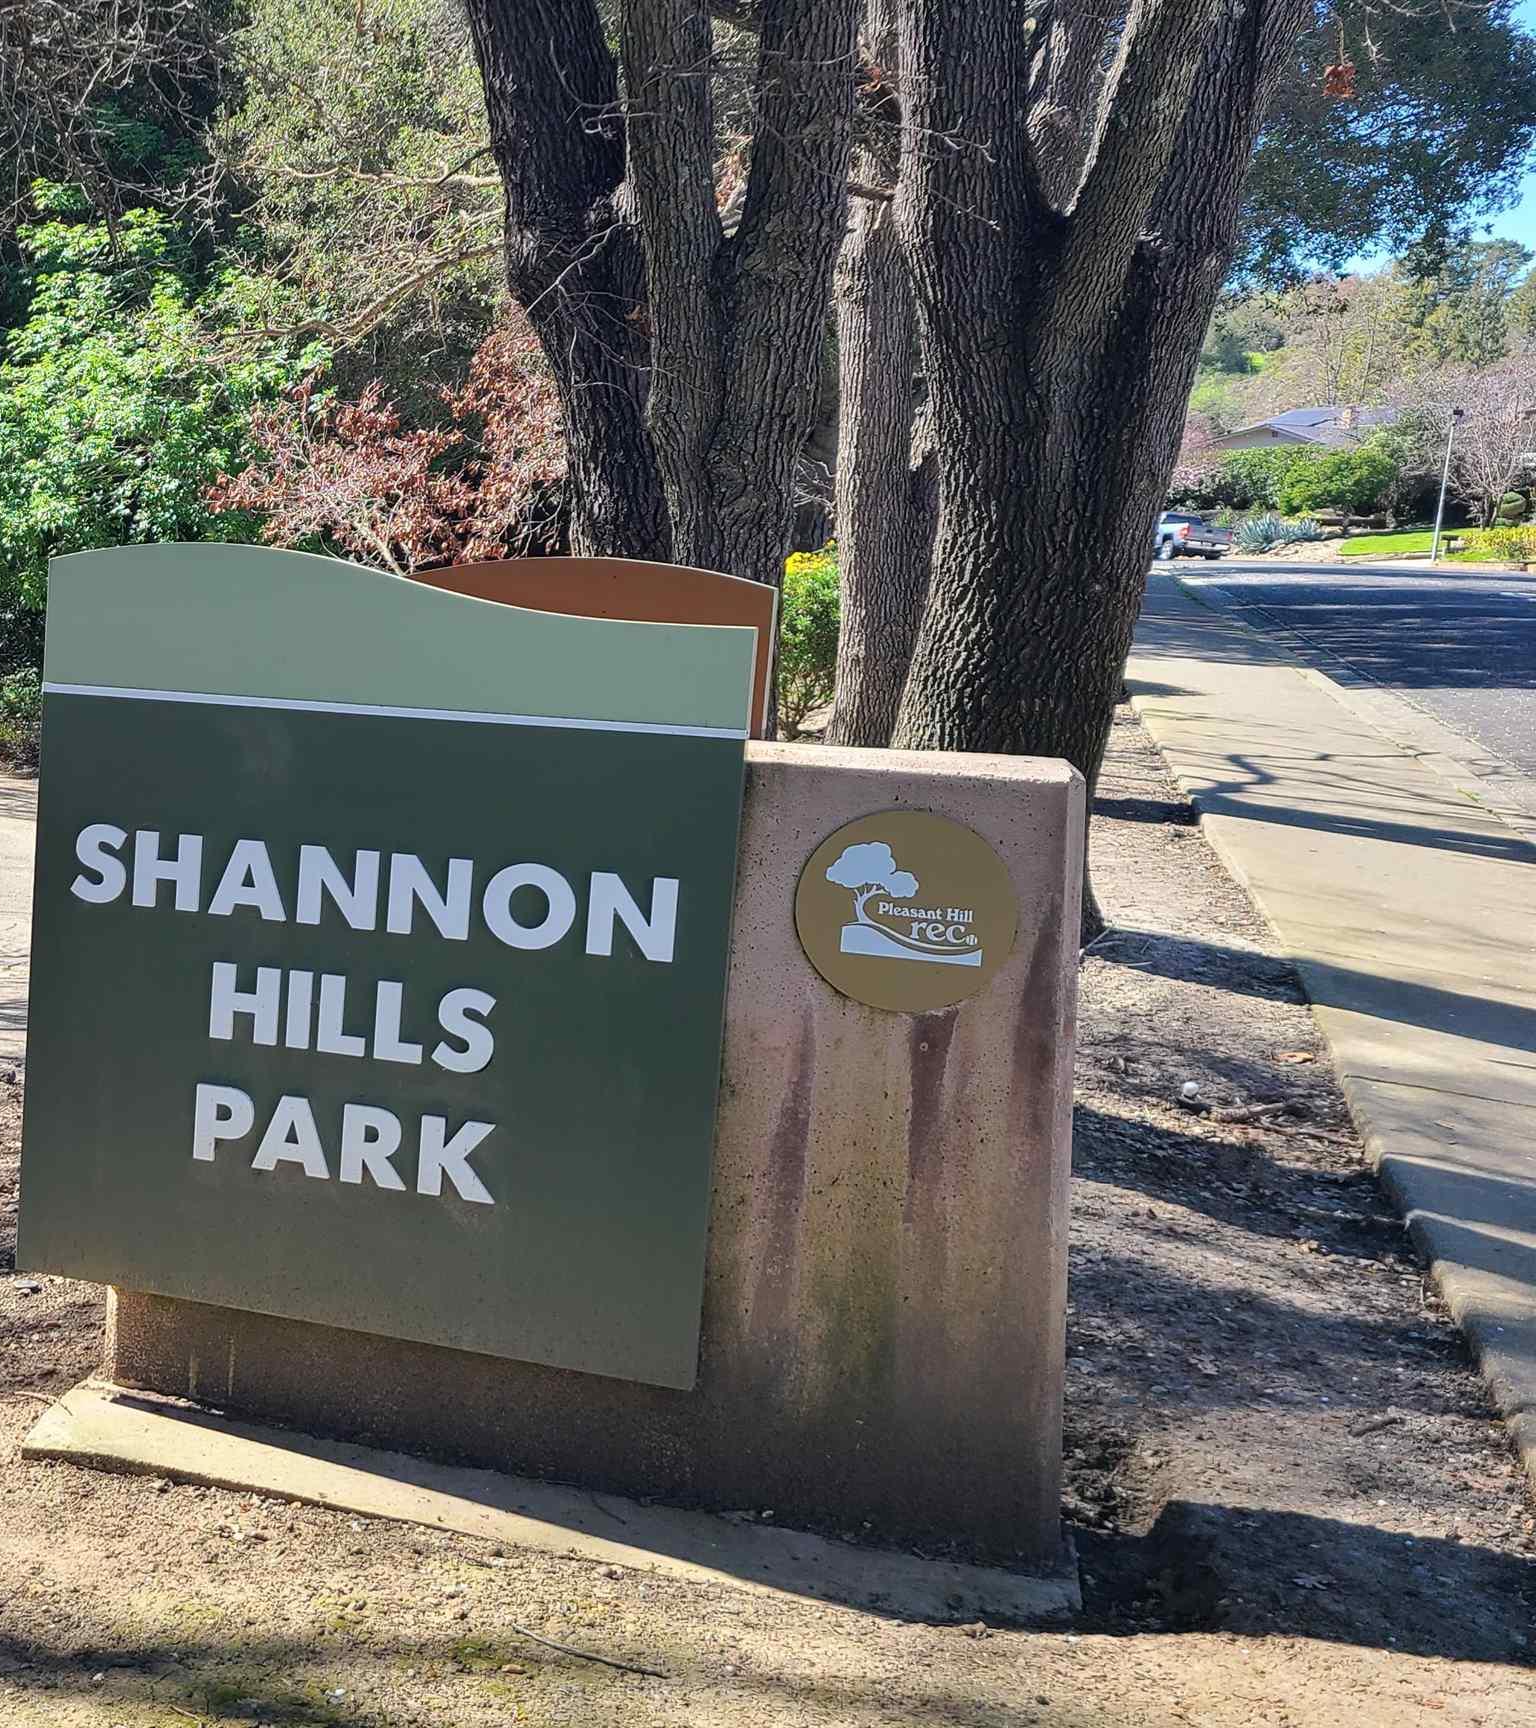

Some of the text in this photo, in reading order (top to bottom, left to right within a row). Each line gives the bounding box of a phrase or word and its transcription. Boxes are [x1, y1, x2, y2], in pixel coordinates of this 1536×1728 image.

[70, 823, 679, 963] SHANNON
[878, 901, 974, 923] Pleasant Hill
[910, 920, 967, 944] rec
[209, 961, 497, 1073] HILLS
[193, 1083, 497, 1205] PARK
